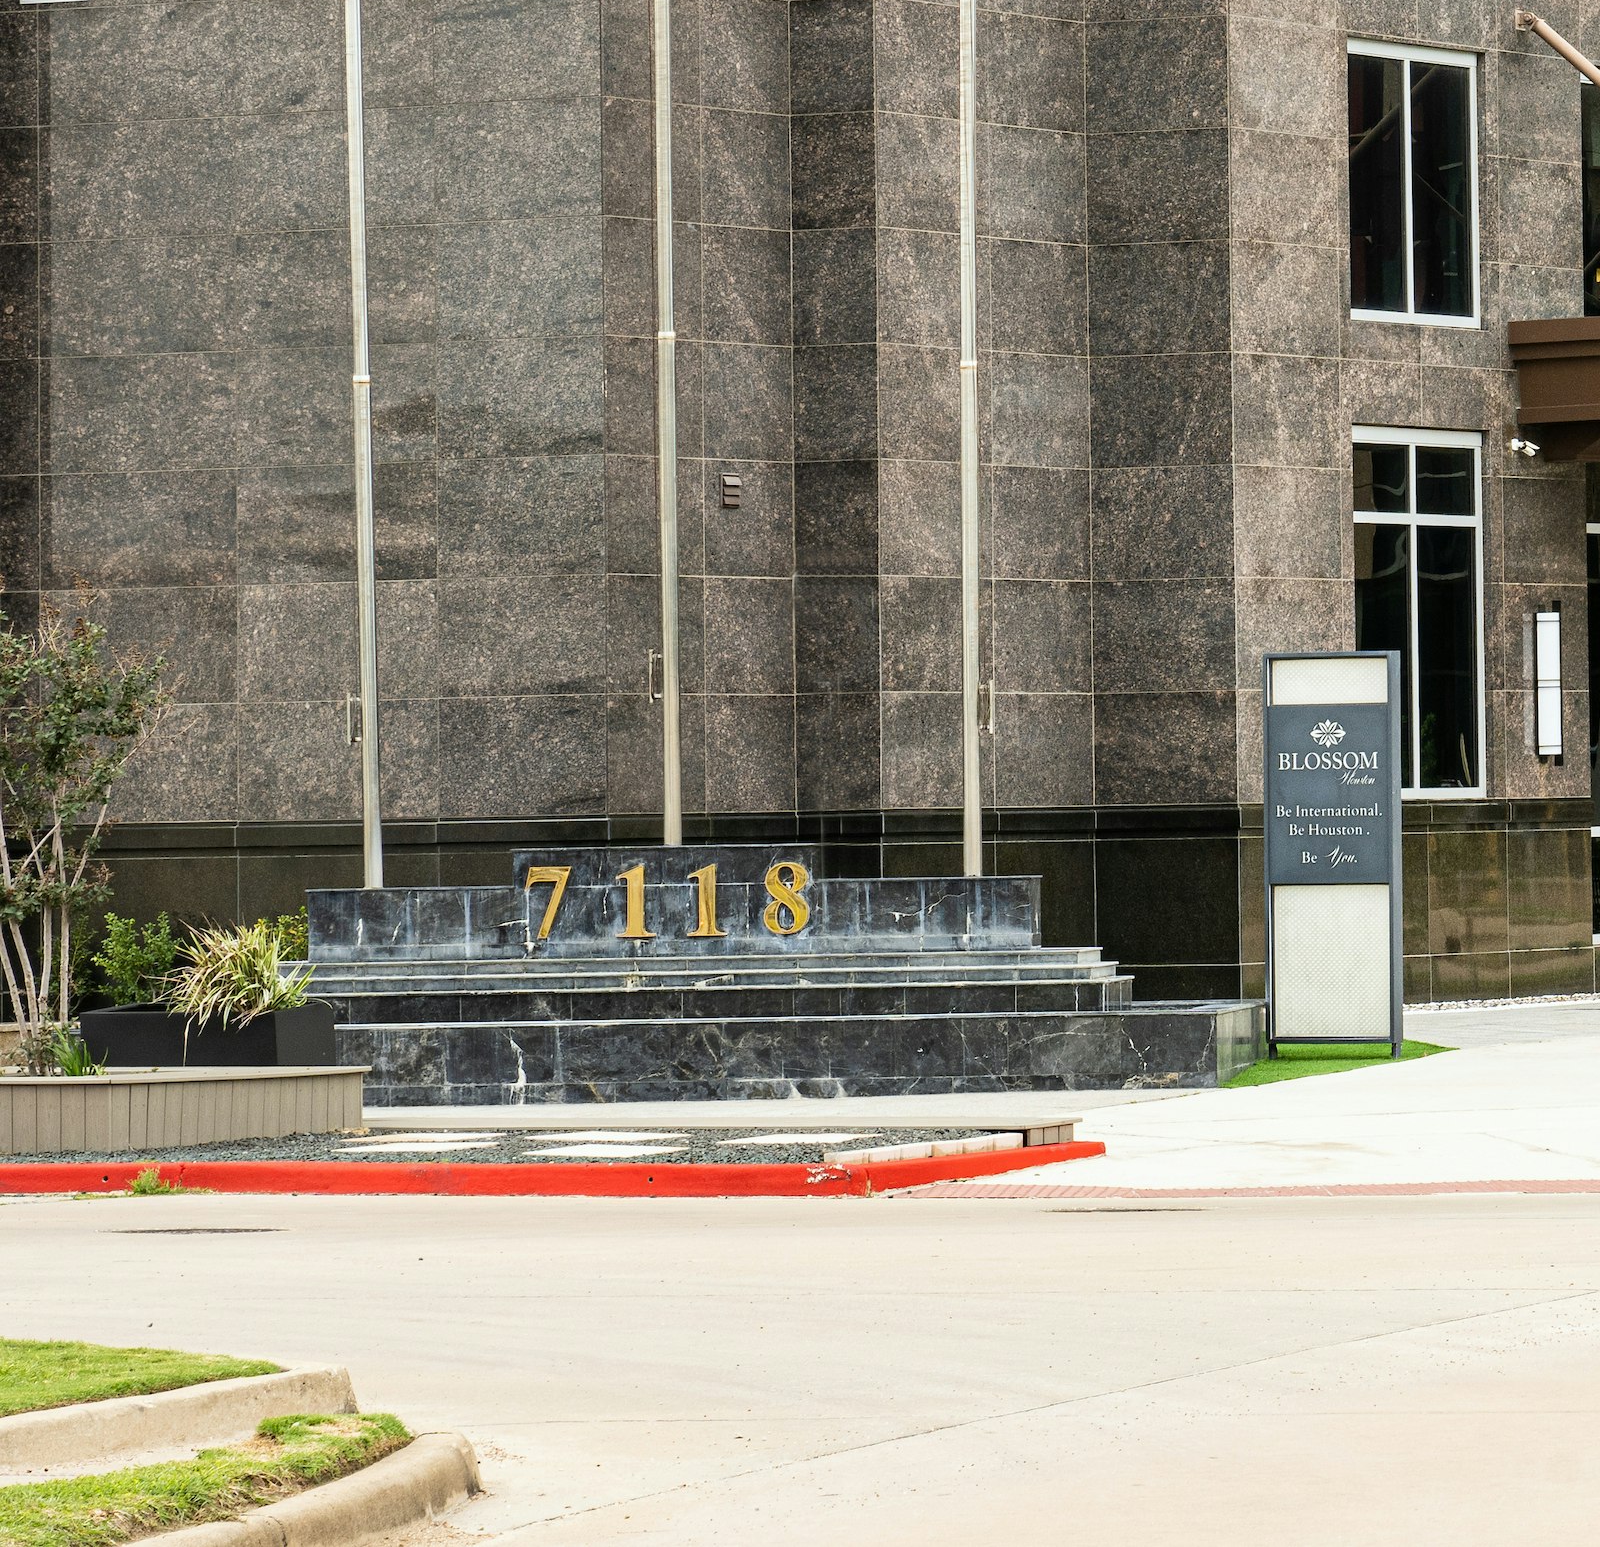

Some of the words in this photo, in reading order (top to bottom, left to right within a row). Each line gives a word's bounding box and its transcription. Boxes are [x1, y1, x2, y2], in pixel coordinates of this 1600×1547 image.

[1278, 751, 1379, 770] BLOSSOM
[1335, 764, 1376, 785] Houston
[1276, 804, 1292, 817] Be
[1296, 803, 1383, 817] International.
[1289, 823, 1304, 836] Be
[1302, 851, 1318, 863] Be
[524, 861, 811, 940] 7118
